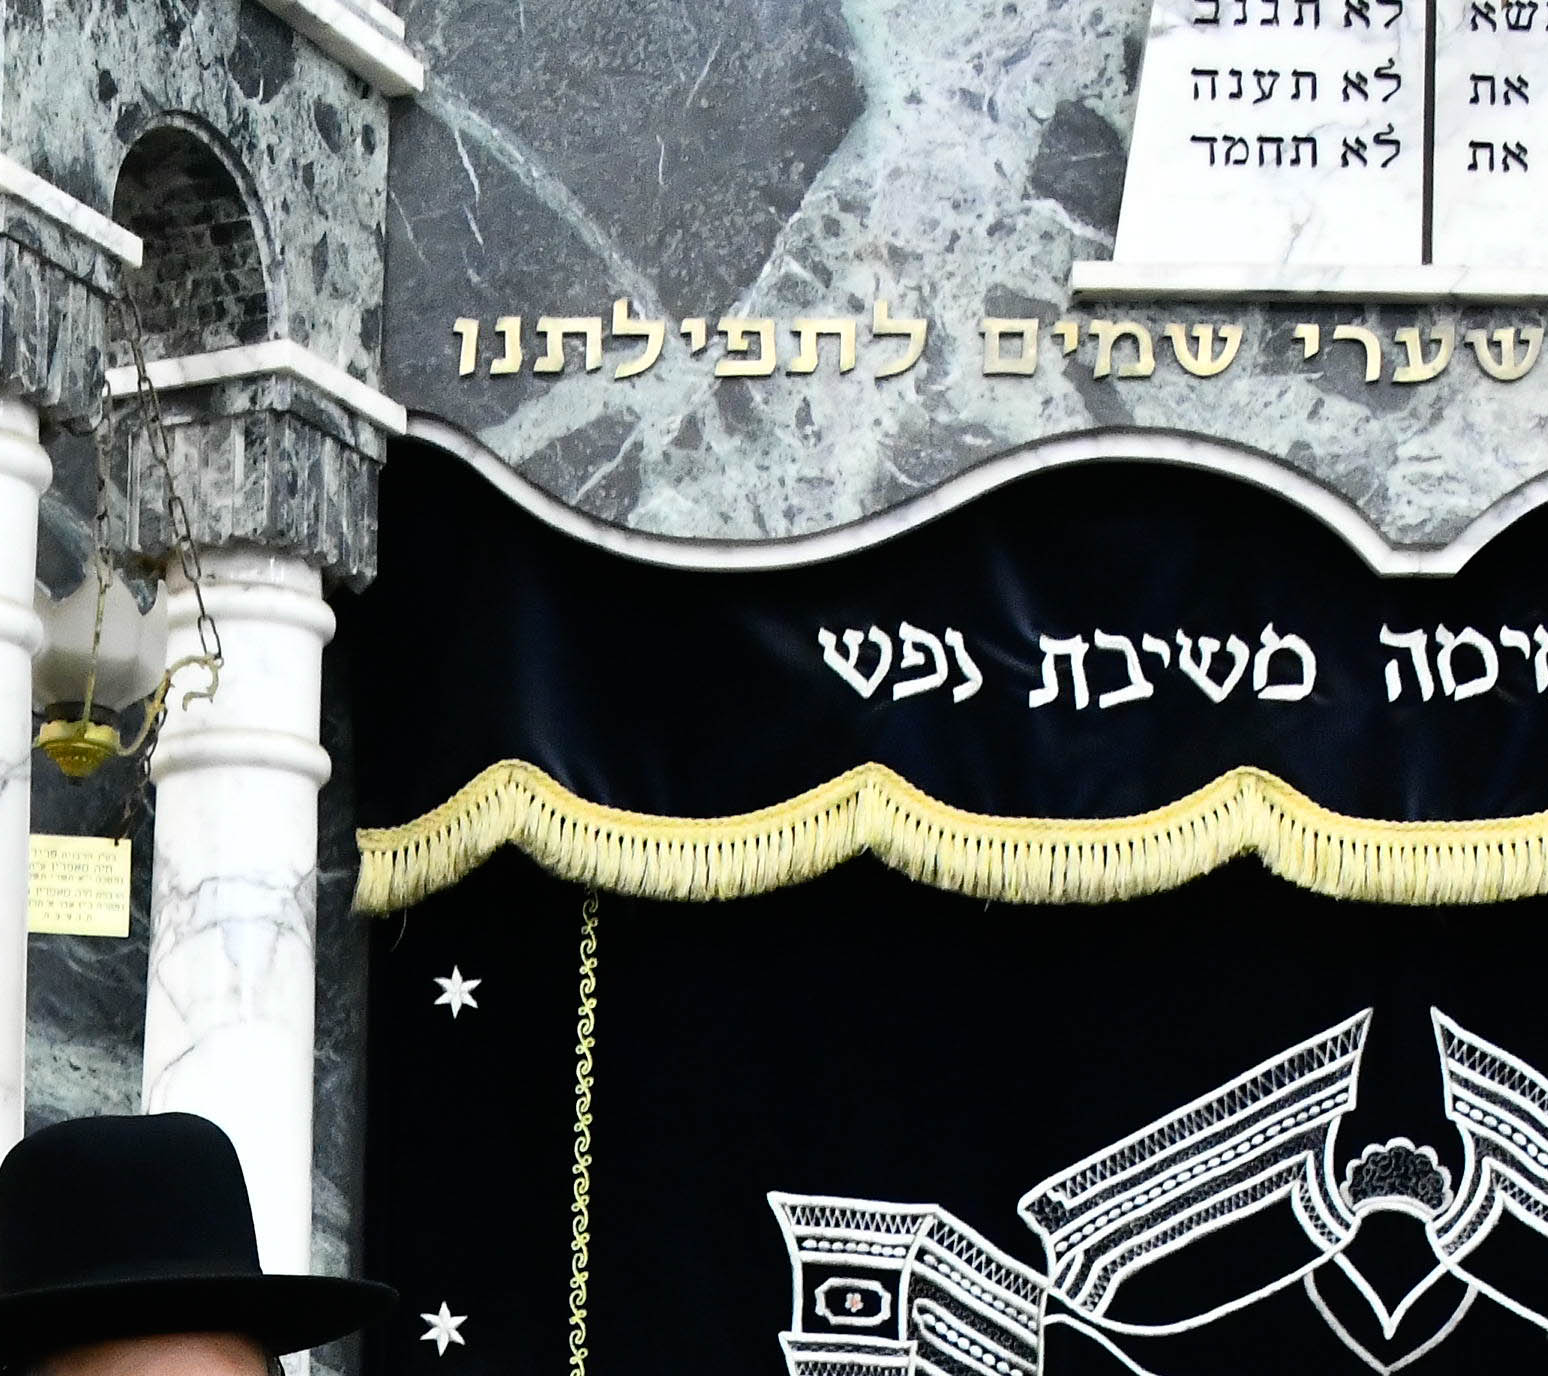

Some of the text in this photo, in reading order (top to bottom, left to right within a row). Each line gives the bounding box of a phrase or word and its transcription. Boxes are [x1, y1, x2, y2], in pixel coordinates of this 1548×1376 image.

[1193, 0, 1403, 29] לא תגנב
[1190, 57, 1402, 104] לא תענה
[1469, 74, 1529, 108] את
[1190, 123, 1401, 168] לא תחמד
[1467, 140, 1528, 173] את
[453, 297, 928, 379] לתפילתנו
[981, 315, 1244, 378] שמים
[1293, 321, 1547, 384] שערי
[818, 621, 984, 704] נפש
[1028, 621, 1317, 711] משיבת
